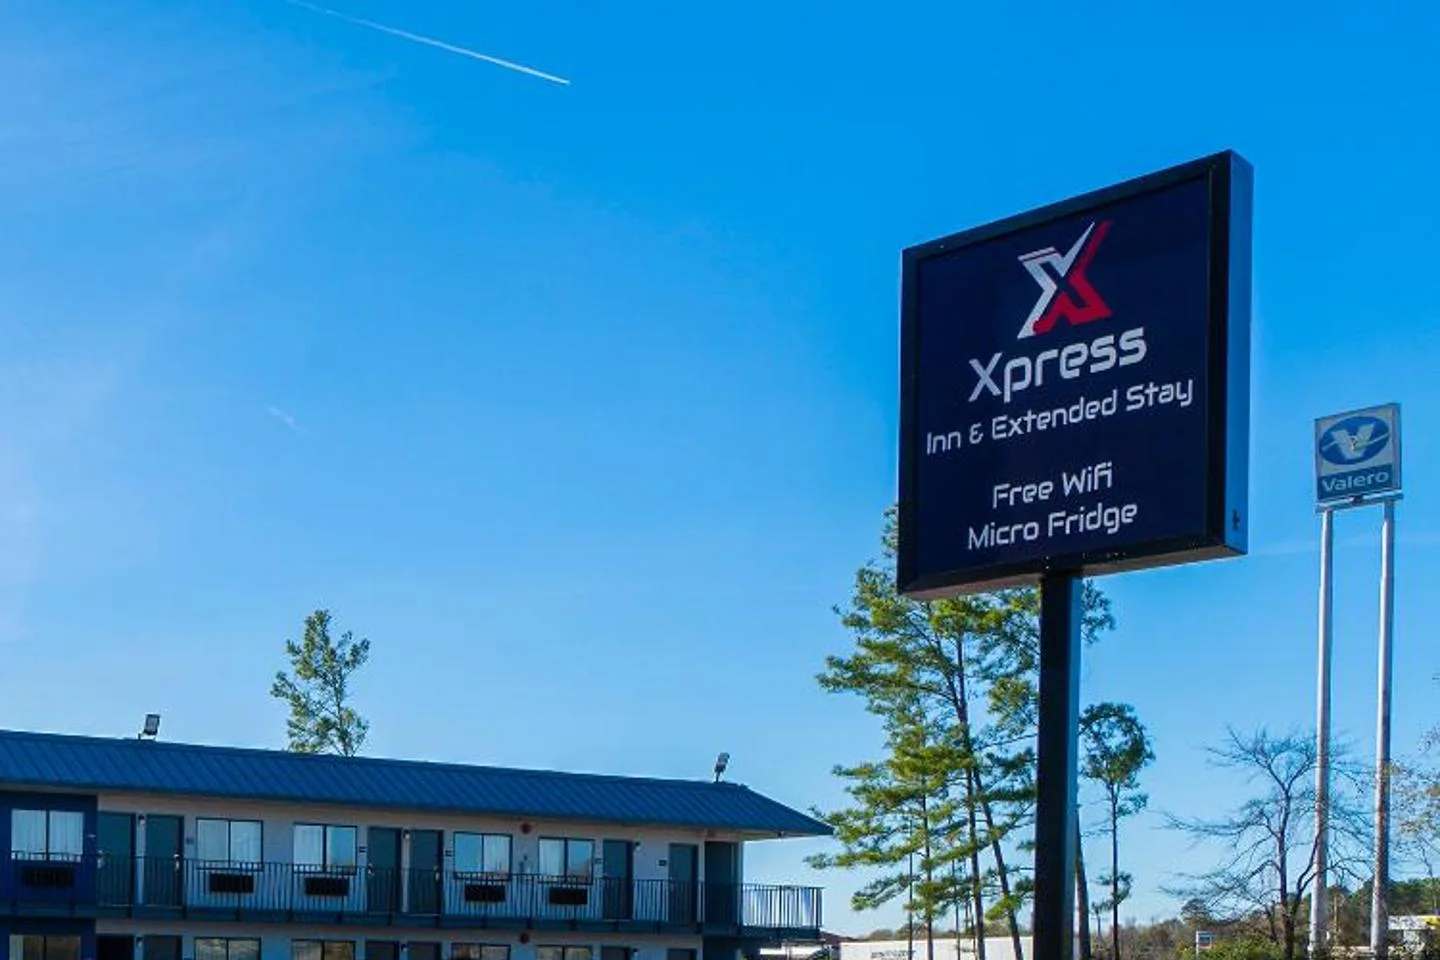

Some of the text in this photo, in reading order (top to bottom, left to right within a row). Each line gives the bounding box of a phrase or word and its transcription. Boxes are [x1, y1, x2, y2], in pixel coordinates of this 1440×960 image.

[968, 326, 1148, 404] Xpress
[926, 378, 1194, 455] Inn & Extended Stay
[992, 461, 1113, 509] Free Wifi
[1321, 471, 1390, 493] Valero
[967, 502, 1139, 550] Micro Fridge
